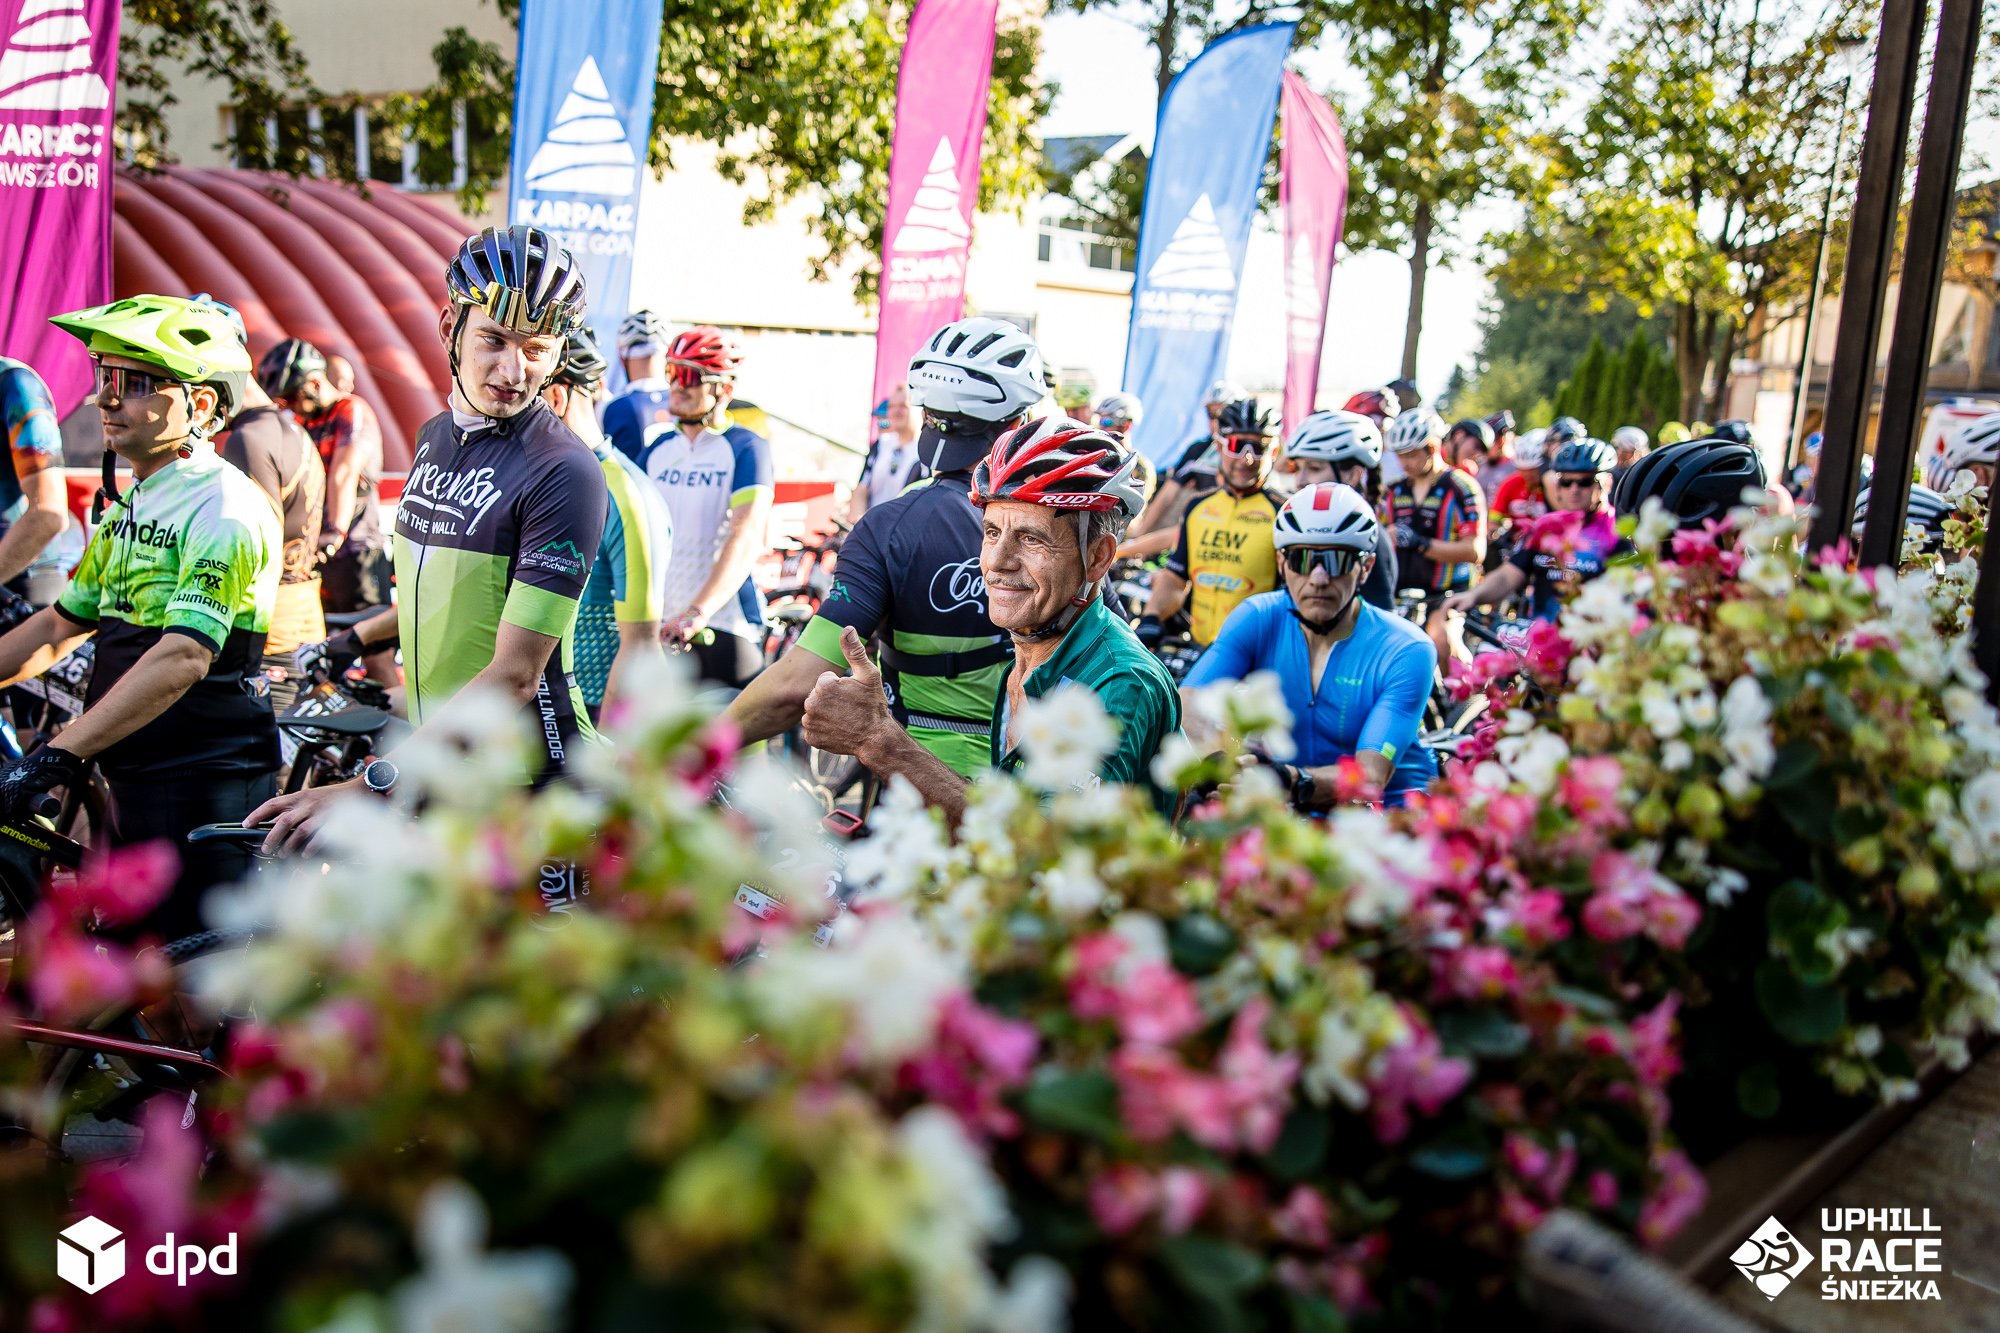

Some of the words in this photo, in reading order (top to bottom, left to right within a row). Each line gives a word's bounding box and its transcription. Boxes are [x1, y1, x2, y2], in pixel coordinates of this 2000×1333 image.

[921, 372, 964, 385] OAKLEY
[656, 468, 728, 488] ADENT
[1038, 494, 1102, 505] RUDY
[410, 513, 430, 534] THE
[431, 521, 458, 536] WALL
[1200, 529, 1248, 549] LEW
[174, 593, 229, 616] HIMANO
[0, 825, 51, 852] annondale
[747, 899, 760, 909] dpd
